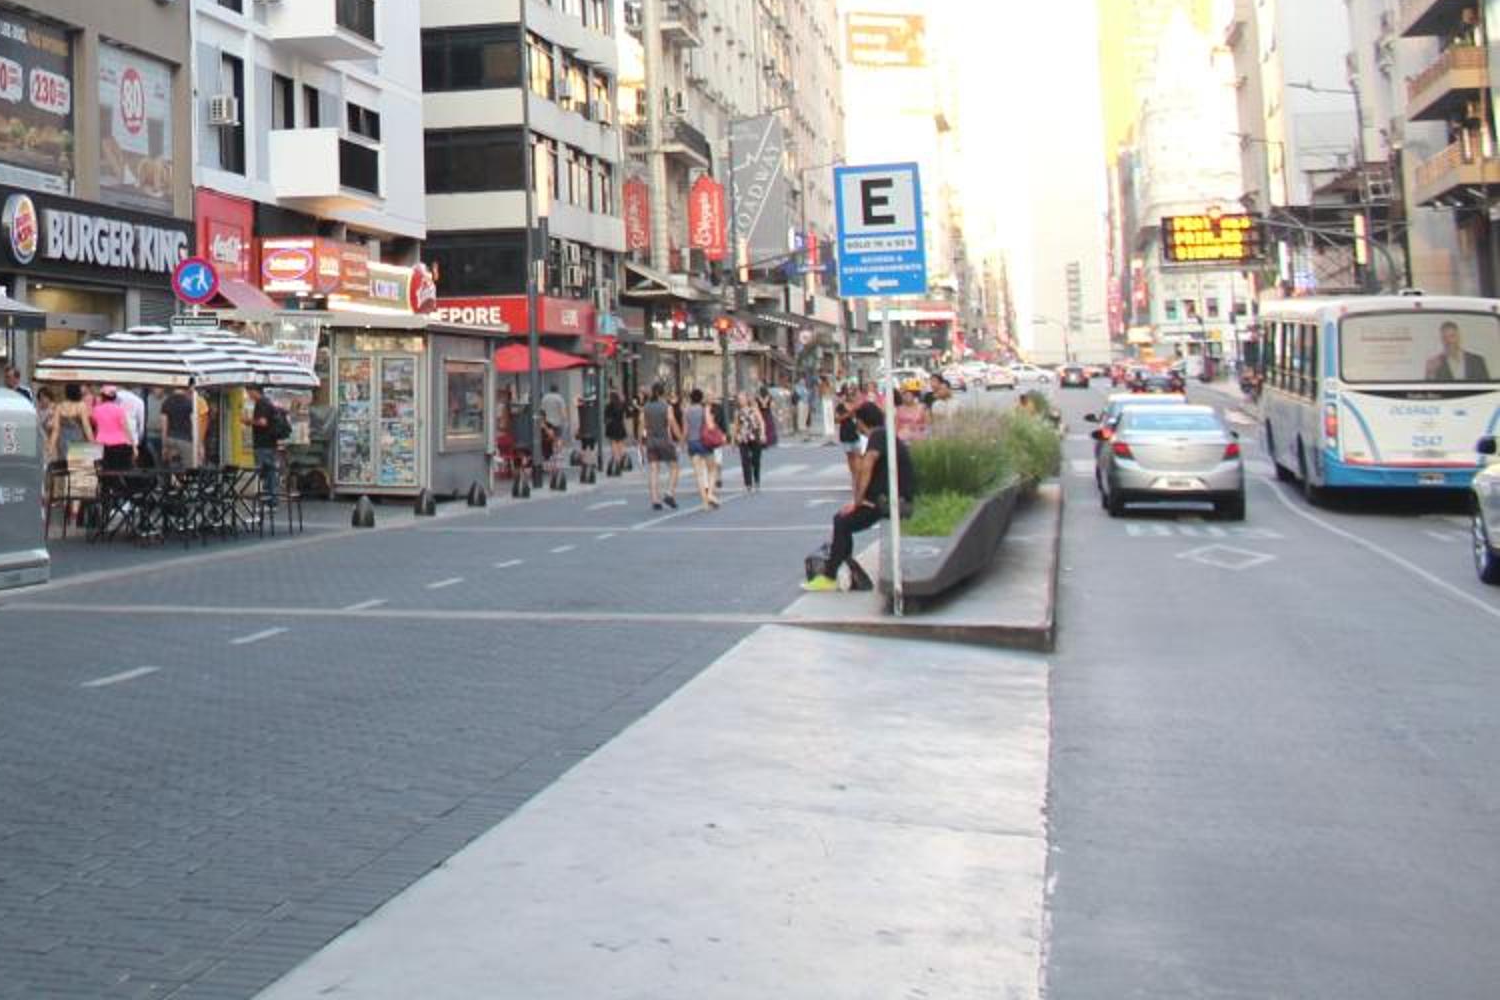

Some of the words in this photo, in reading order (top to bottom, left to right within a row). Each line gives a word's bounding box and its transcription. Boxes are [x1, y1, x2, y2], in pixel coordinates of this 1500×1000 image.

[34, 73, 58, 105] 230
[861, 178, 896, 226] E
[45, 209, 135, 269] BURGER
[134, 225, 187, 273] KING
